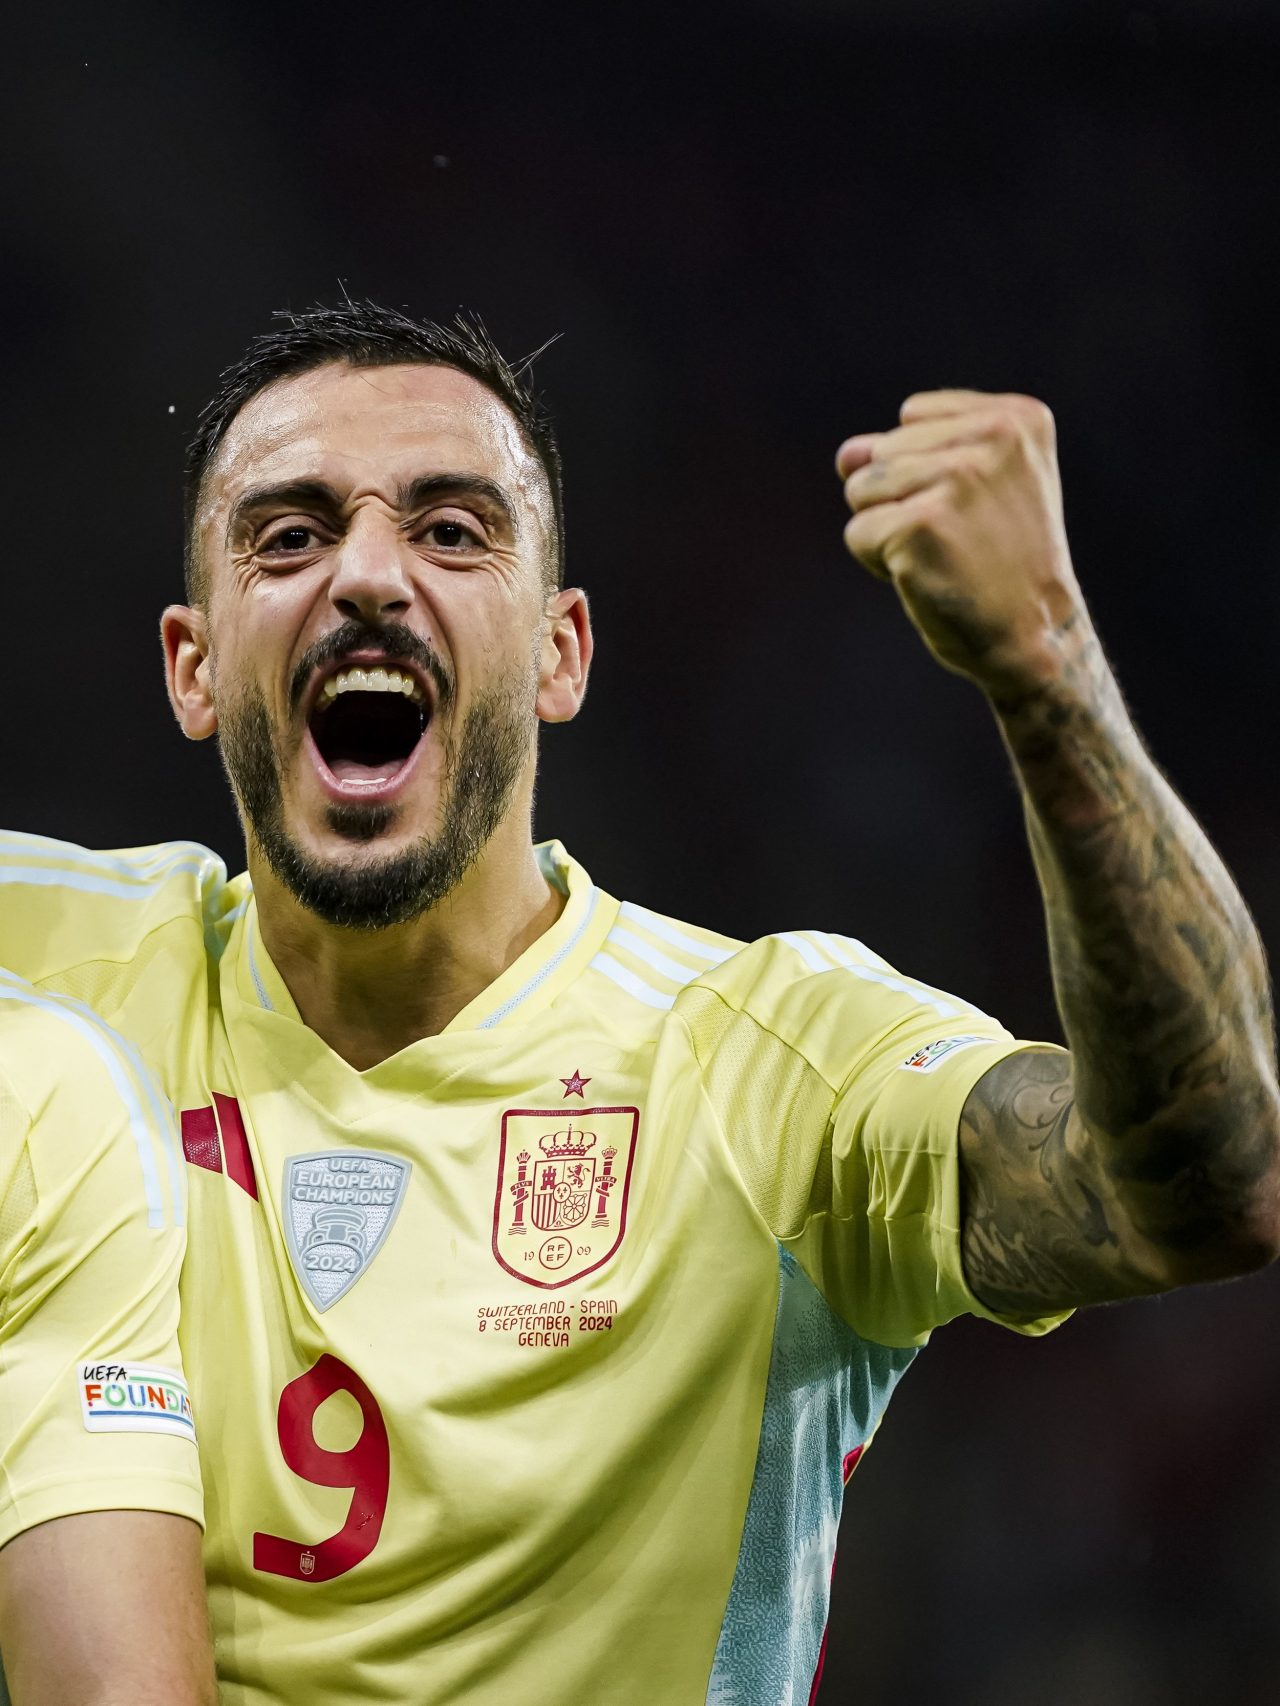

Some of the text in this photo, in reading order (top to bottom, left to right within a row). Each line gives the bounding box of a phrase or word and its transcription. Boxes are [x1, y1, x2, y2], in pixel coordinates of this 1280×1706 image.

[330, 1159, 369, 1172] UEFA
[297, 1170, 396, 1190] EUROPEAN
[294, 1187, 395, 1205] CHAMPIONS
[524, 1251, 535, 1261] 19
[576, 1246, 591, 1256] 09
[307, 1254, 357, 1272] 2024
[477, 1301, 565, 1318] SWITZERLAND
[580, 1300, 618, 1314] SPAIN
[479, 1316, 613, 1333] 8 SEPTEMBER 2024
[518, 1332, 569, 1347] GENEVA
[83, 1365, 128, 1381] UEFA
[253, 1353, 390, 1583] 9
